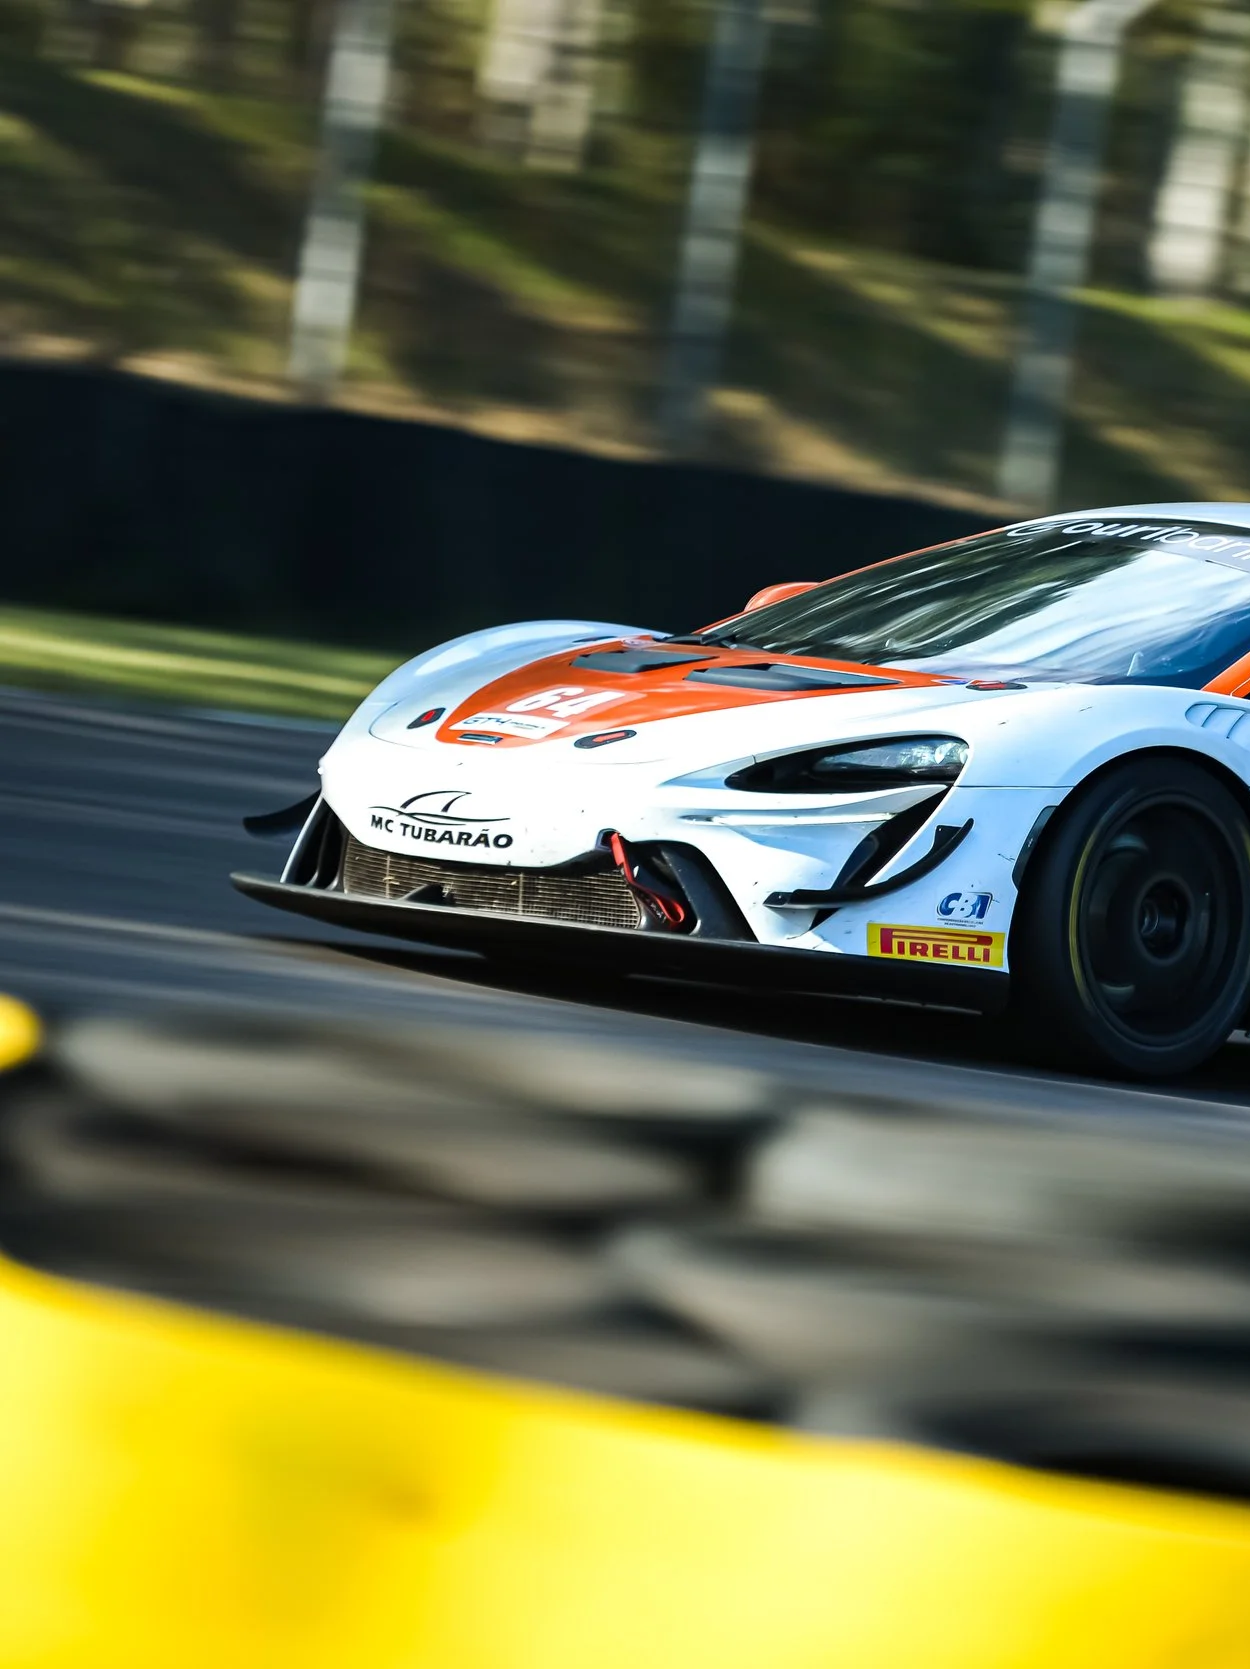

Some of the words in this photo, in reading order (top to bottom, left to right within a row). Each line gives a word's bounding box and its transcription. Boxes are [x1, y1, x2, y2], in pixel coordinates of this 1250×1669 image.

[505, 687, 626, 719] 64
[370, 815, 393, 833] MC
[400, 823, 513, 850] TUBARÃO
[880, 927, 993, 963] PIRELLI
